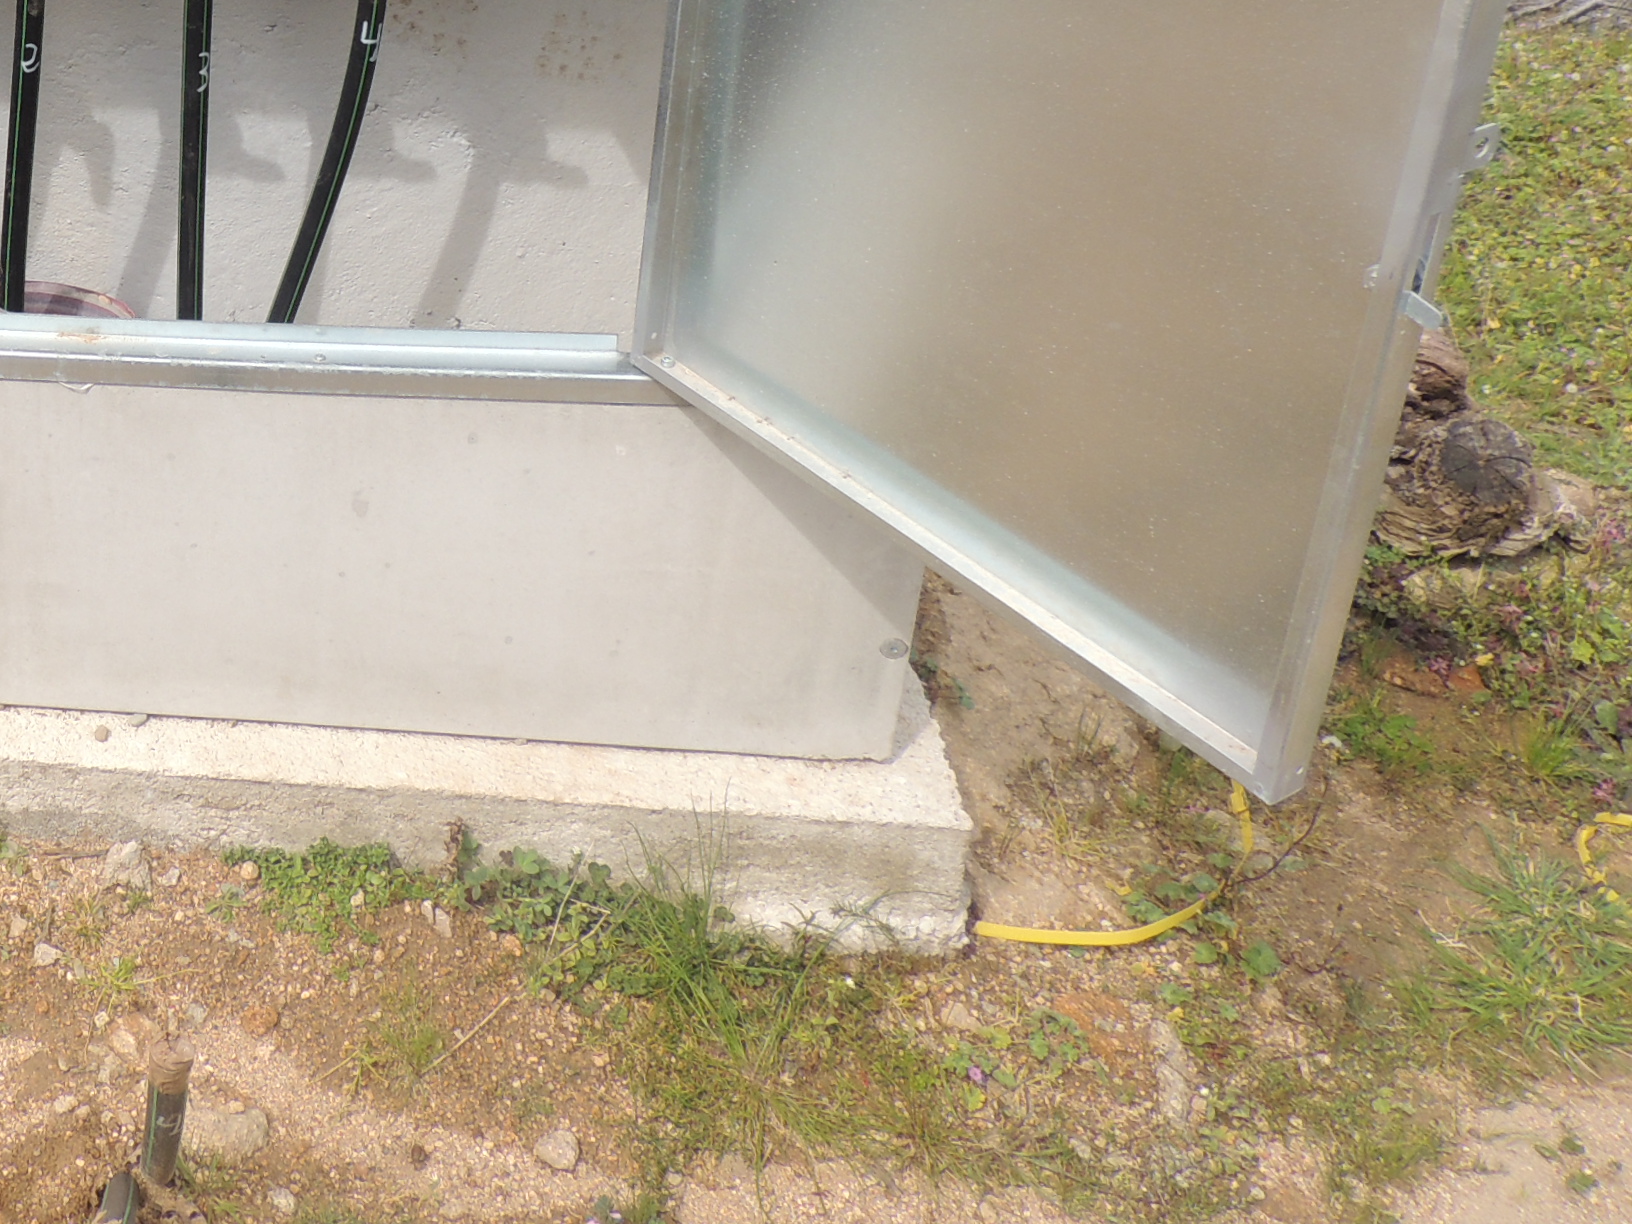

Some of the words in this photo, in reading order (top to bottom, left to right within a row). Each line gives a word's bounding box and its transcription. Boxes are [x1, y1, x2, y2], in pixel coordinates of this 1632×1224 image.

[20, 42, 40, 74] 2
[360, 20, 383, 63] 4
[196, 51, 210, 93] 3
